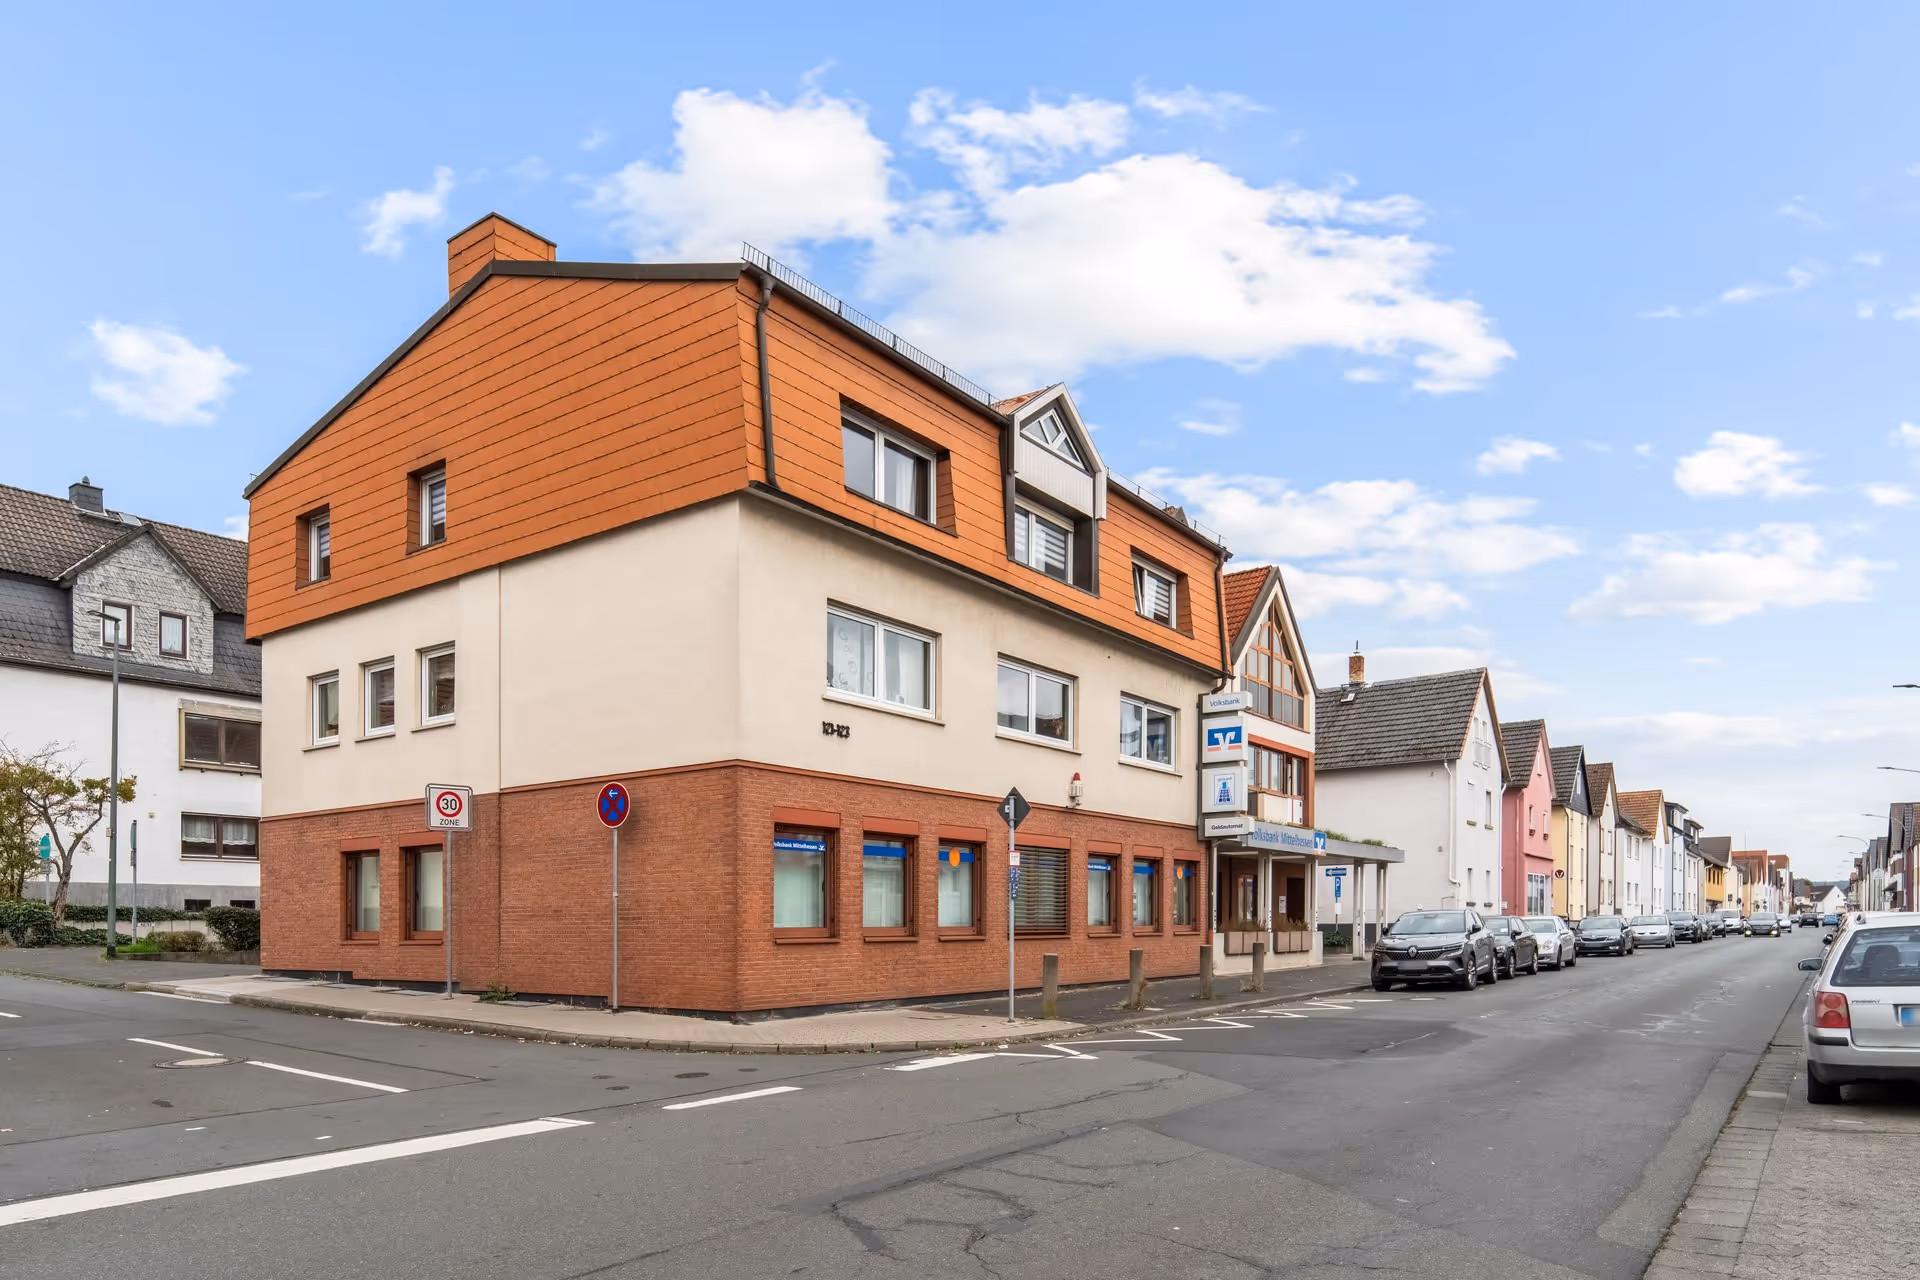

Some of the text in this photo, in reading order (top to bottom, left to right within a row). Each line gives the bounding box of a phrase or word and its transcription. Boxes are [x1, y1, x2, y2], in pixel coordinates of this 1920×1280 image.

[1210, 698, 1240, 706] Volksbank
[441, 798, 457, 810] 30
[1281, 832, 1313, 848] Mittelhessen
